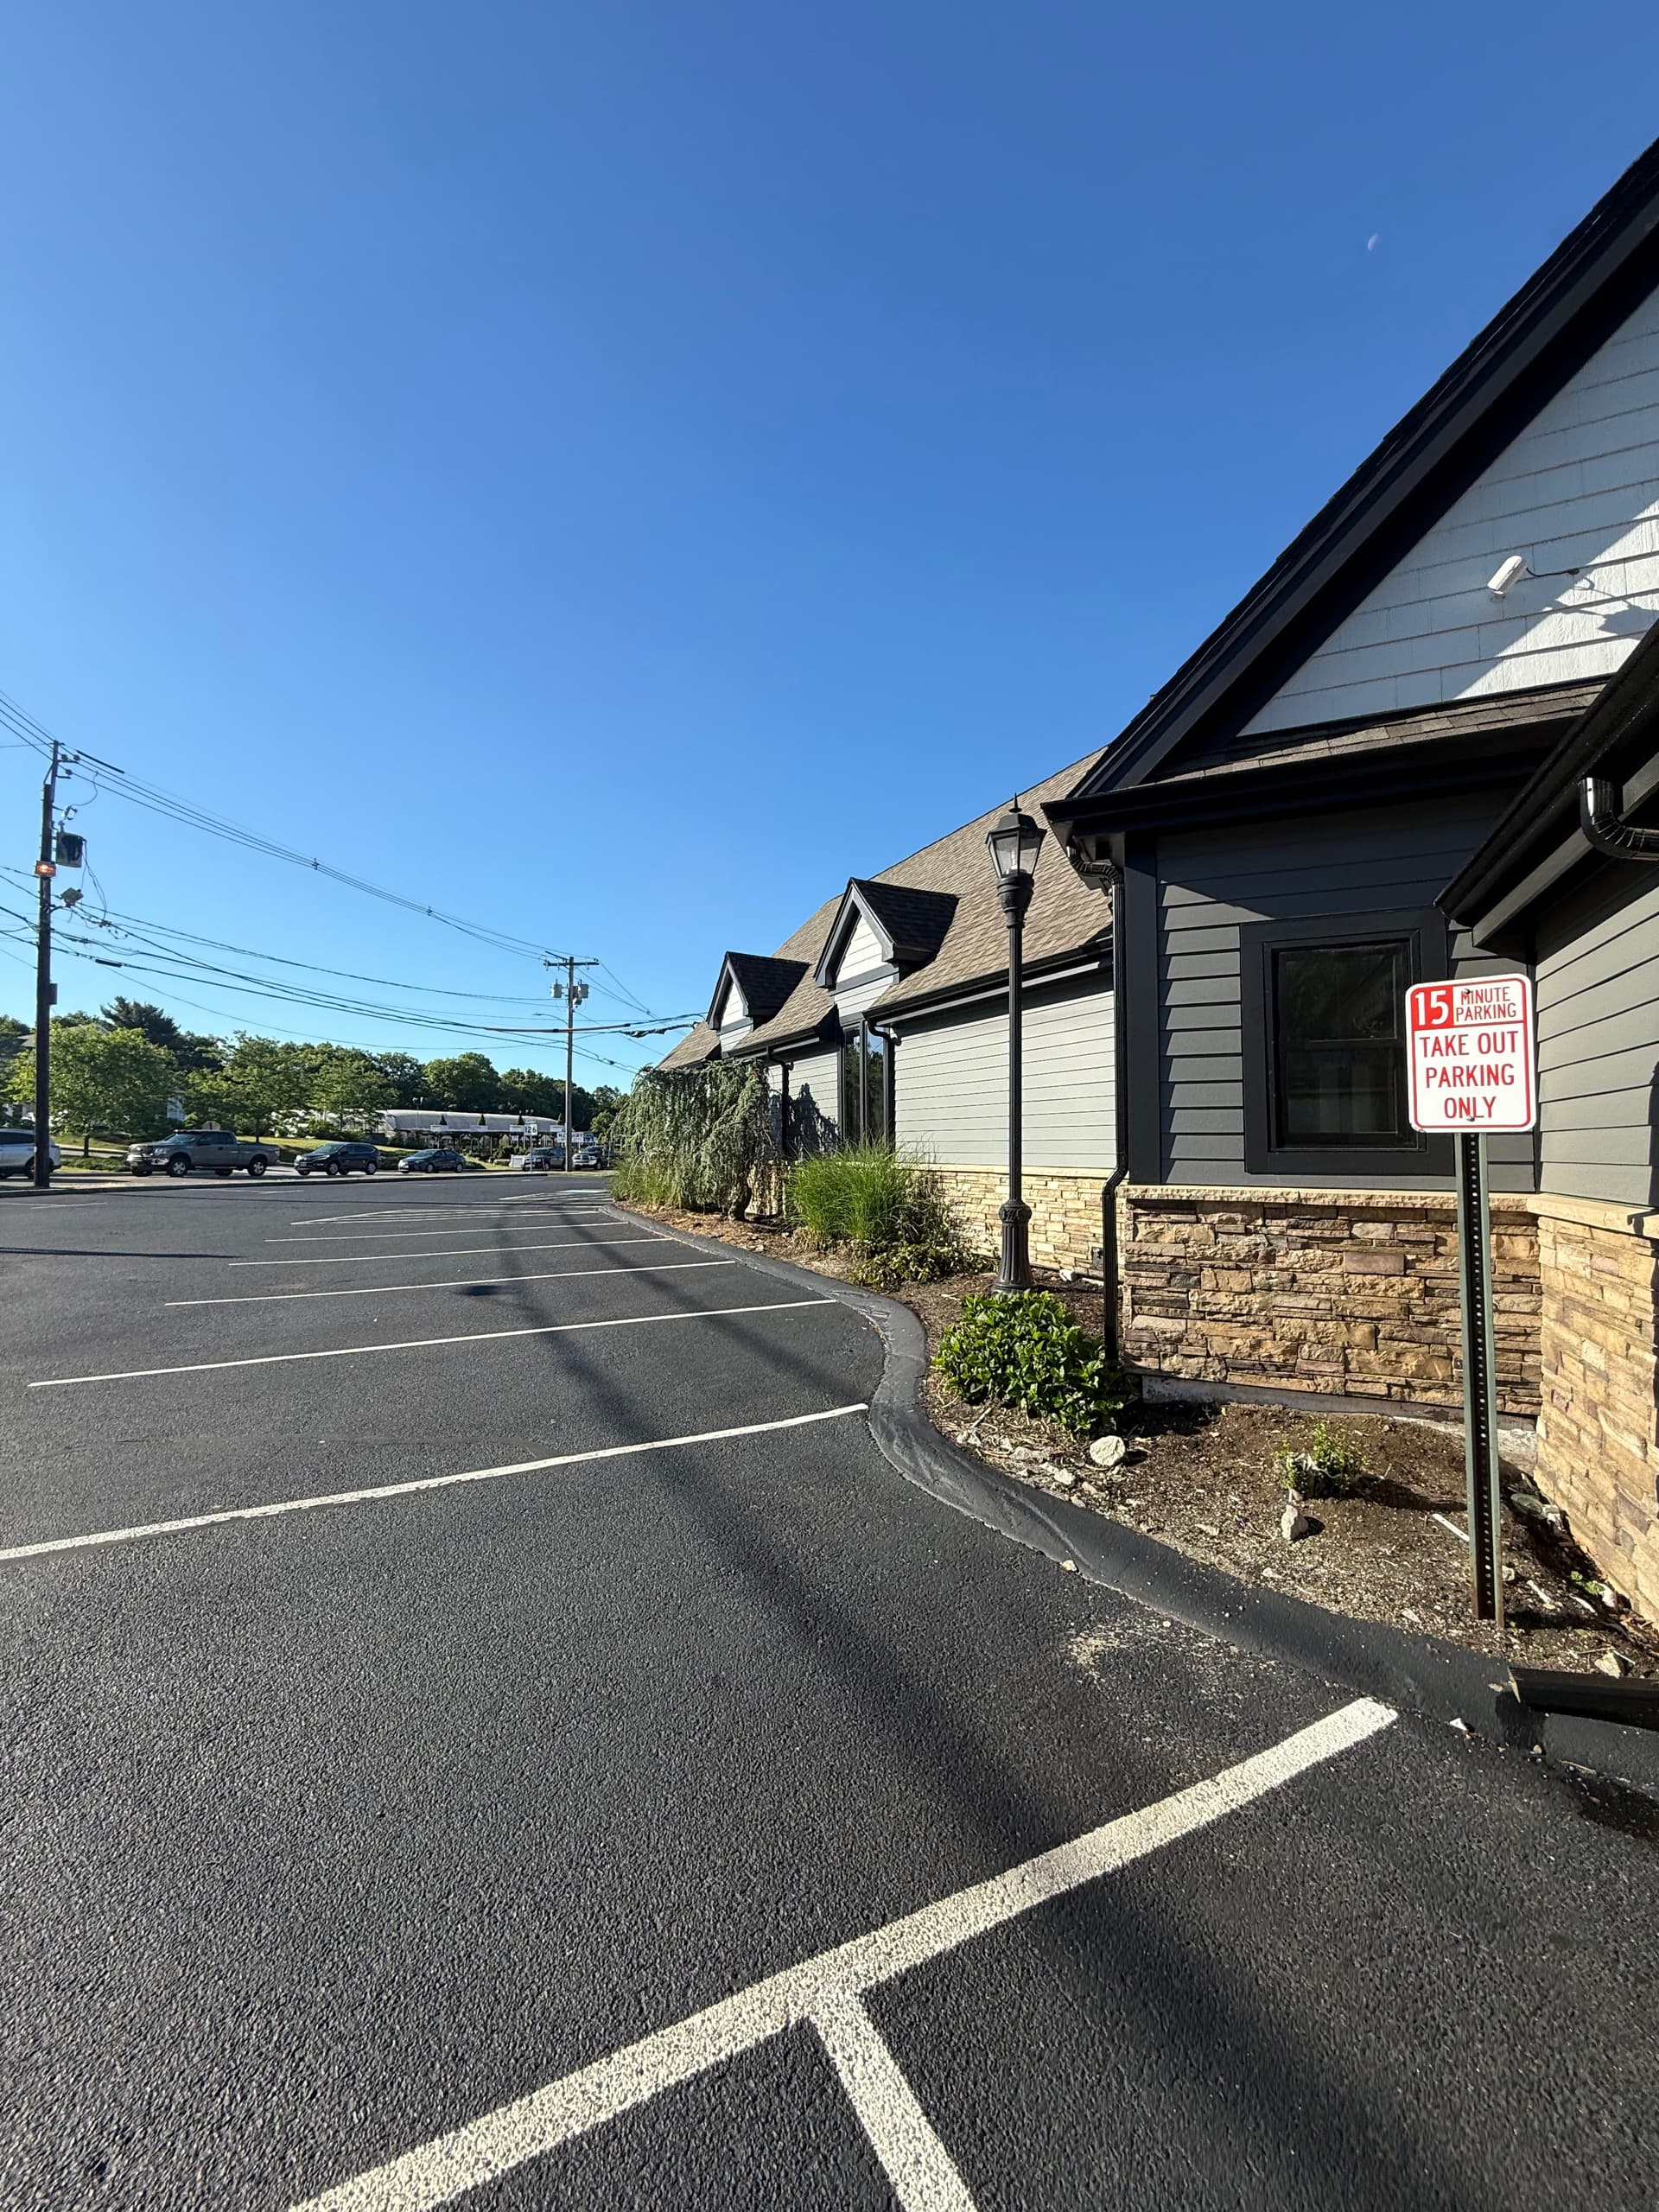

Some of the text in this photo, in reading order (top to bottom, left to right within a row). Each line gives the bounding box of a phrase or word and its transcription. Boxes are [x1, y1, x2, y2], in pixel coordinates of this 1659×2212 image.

[1414, 989, 1449, 1027] 15
[1460, 987, 1511, 1005] MINUTE
[1455, 1002, 1516, 1021] PARKING
[1419, 1031, 1518, 1058] TAKE OUT
[1426, 1063, 1515, 1088] PARKING
[1444, 1096, 1497, 1119] ONLY
